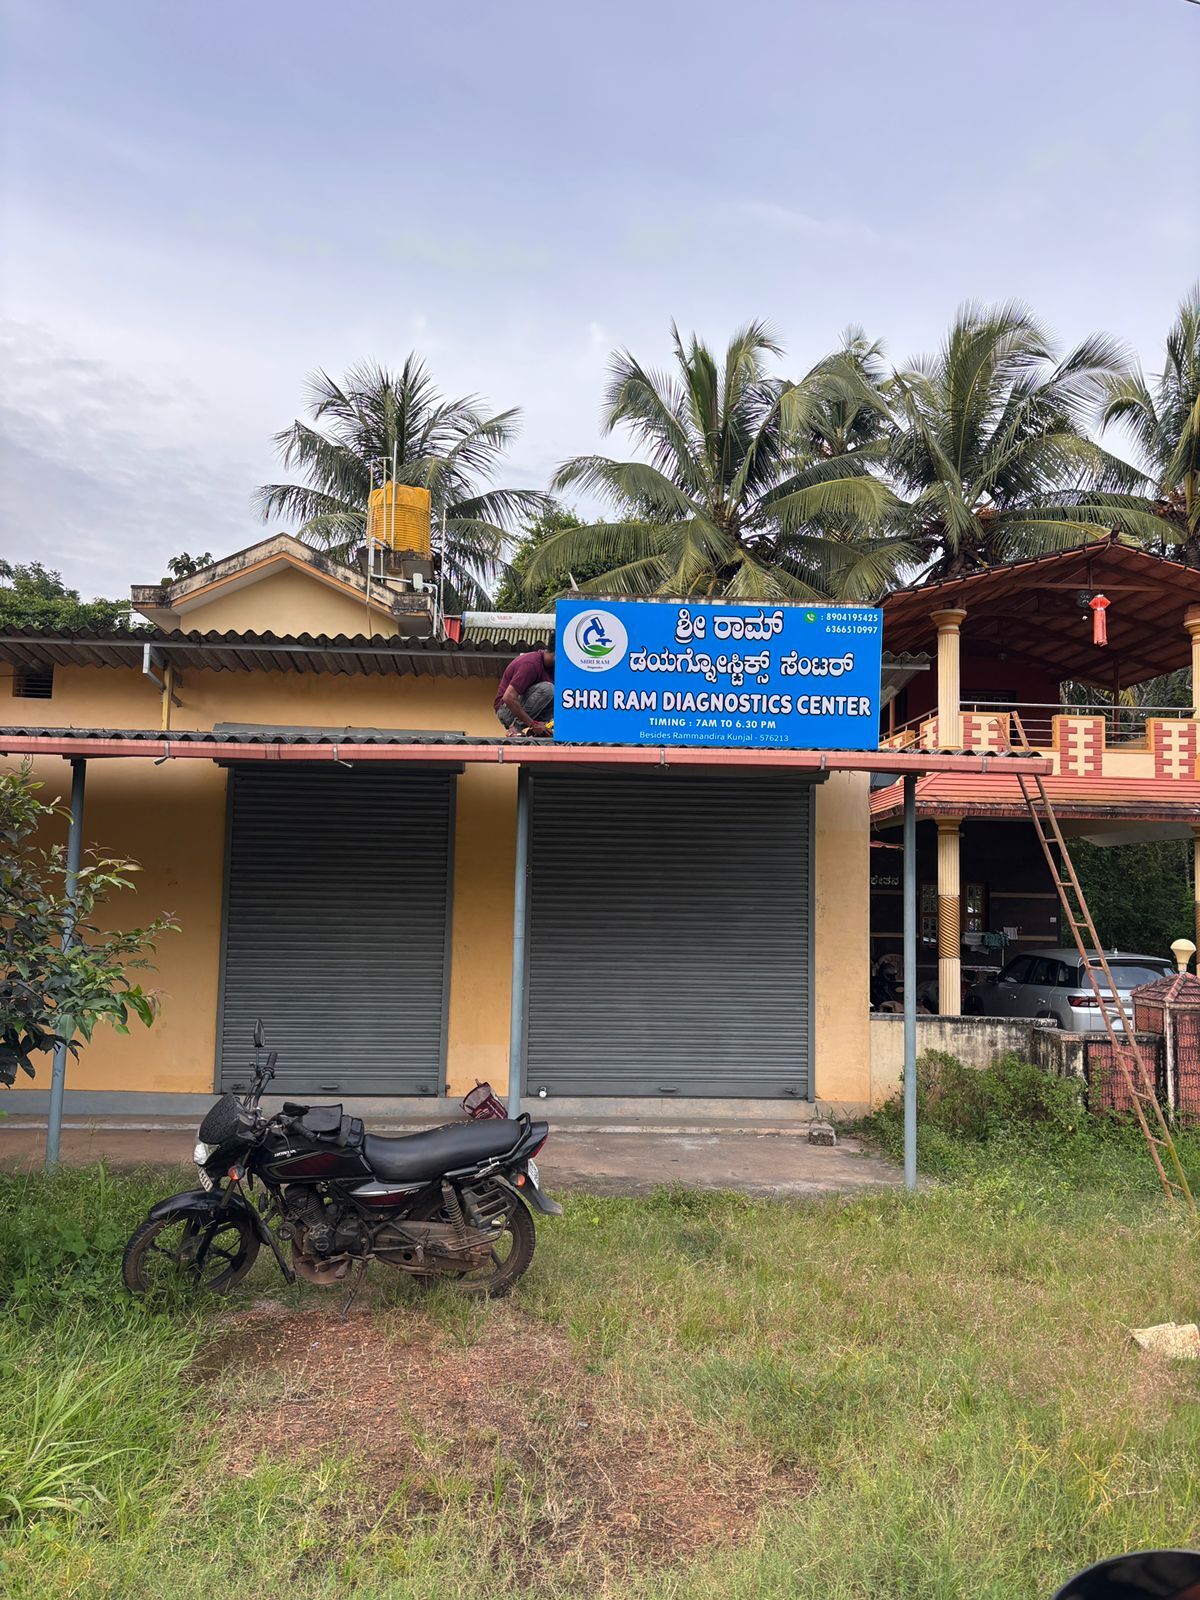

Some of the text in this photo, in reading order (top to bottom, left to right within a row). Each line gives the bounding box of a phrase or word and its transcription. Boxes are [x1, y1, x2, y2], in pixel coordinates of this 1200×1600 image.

[826, 612, 879, 622] 8904195425
[675, 607, 784, 644] ಶ್ರೀ ರಾಮ್
[825, 624, 878, 635] 6366510997
[779, 649, 855, 677] ಸೆಂಟರ್
[561, 688, 872, 717] SHRI RAM DIAGNOSTICS CENTER
[649, 717, 686, 727] TIMING
[695, 718, 718, 728] 7AM
[721, 719, 733, 729] TO
[735, 719, 758, 729] 6.30
[760, 720, 776, 730] PM
[639, 730, 671, 740] Besides
[672, 731, 725, 741] Rammandira
[726, 732, 753, 743] Kunjal
[759, 734, 790, 743] 576213
